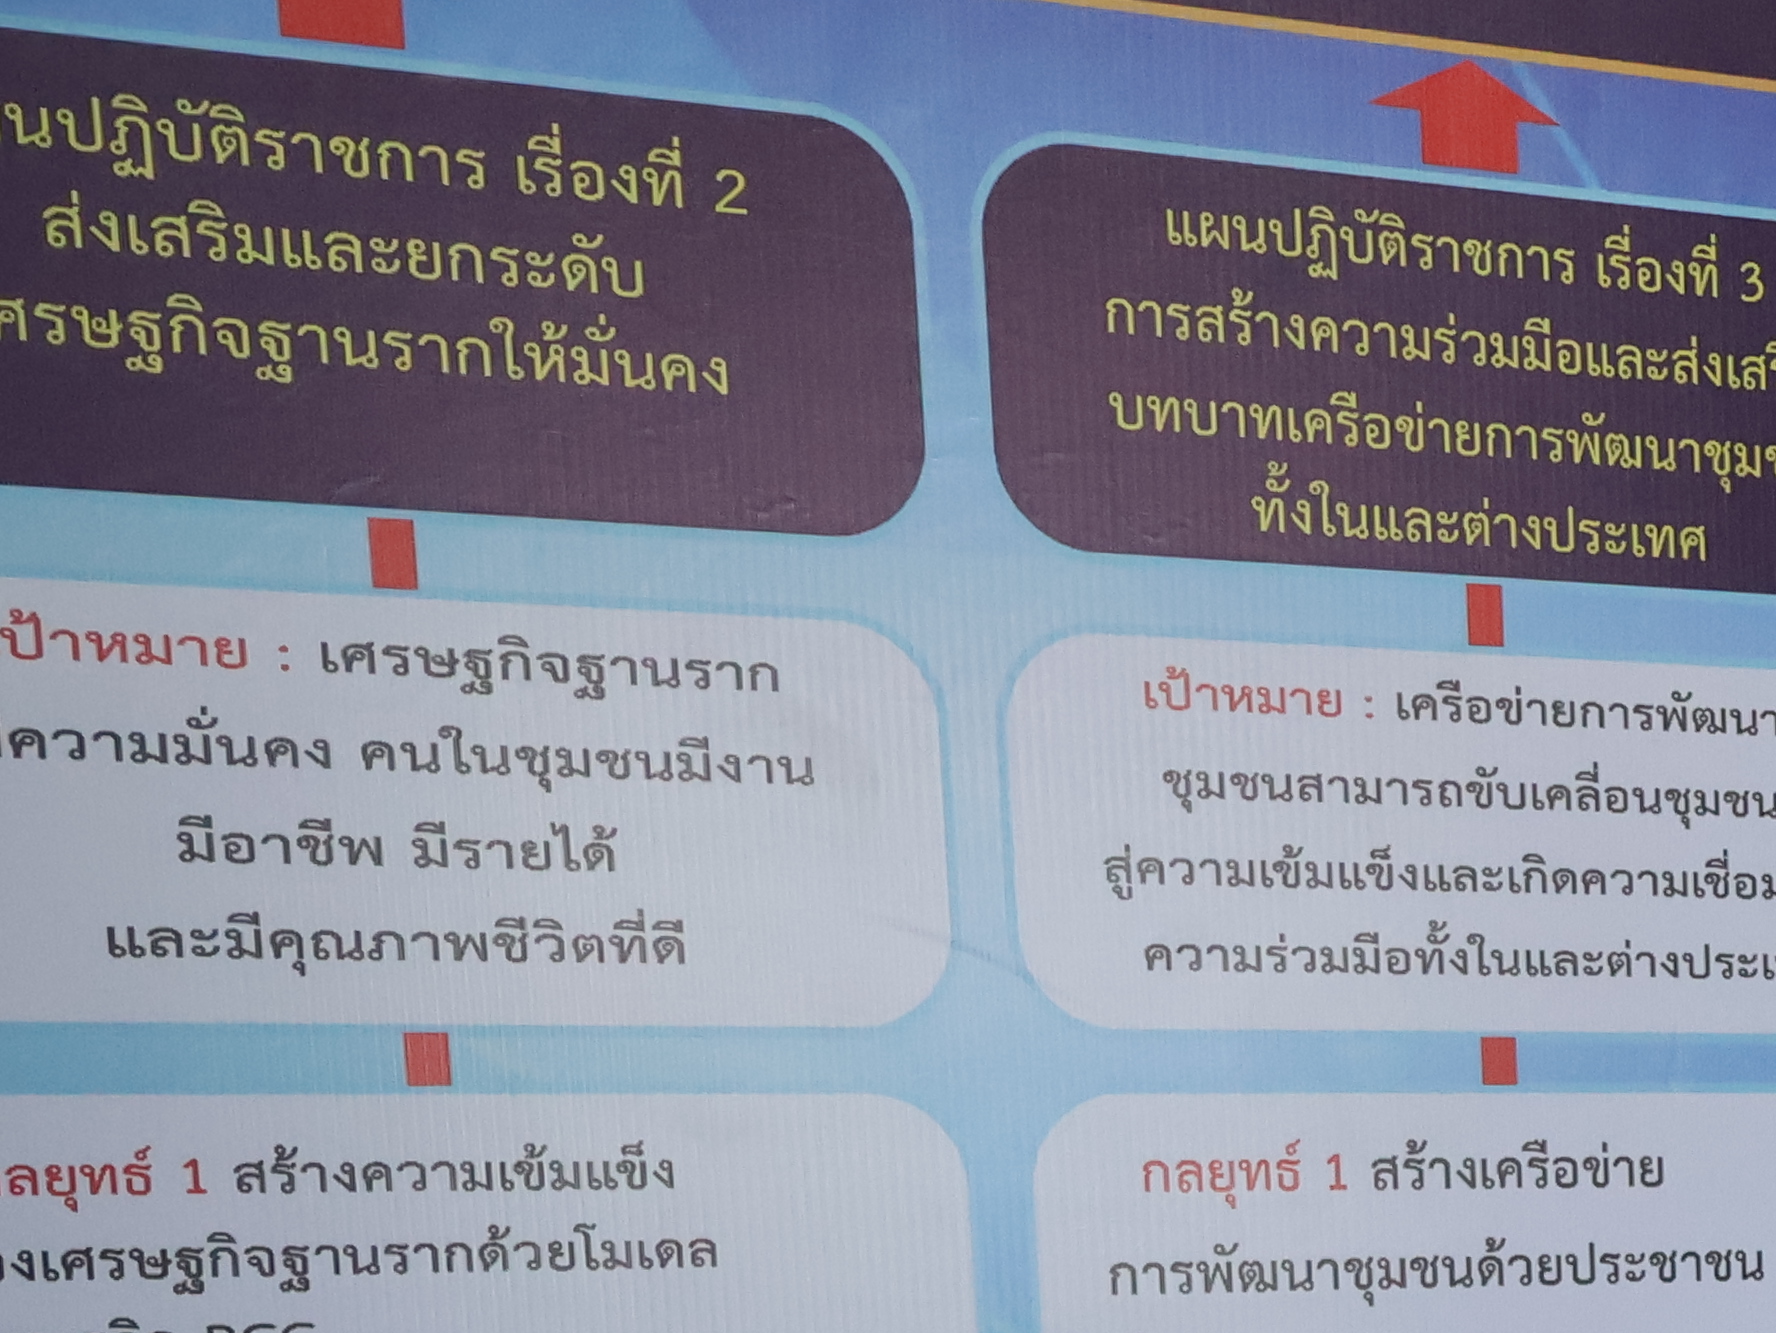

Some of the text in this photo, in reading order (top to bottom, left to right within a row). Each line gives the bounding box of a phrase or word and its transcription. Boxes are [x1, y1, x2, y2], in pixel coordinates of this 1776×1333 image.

[2, 92, 748, 216] นปฏิบัติราชการ เรื่องที่ 2
[42, 190, 645, 300] ส่งเสริมและยกระดับ
[1165, 203, 1766, 303] แผนปฏิบัติราชการ เรื่องที่ 3
[1251, 461, 1709, 564] ทั้งในและต่างประเทศ
[0, 608, 780, 699] ป้าหมาย : เศรษฐกิจฐานราก
[1143, 666, 1343, 720] เป้าหมาย
[1364, 694, 1375, 720] :
[0, 707, 815, 793] ความมั่นคง คนในชุมชนมีงาน
[177, 815, 617, 873] มีอาชีพ มีรายได้
[105, 908, 686, 977] และมีคุณภาพชีวิตที่ดี
[0, 1141, 675, 1212] ลยุทธ์ 1 สร้างความเข้มแข็ง
[1141, 1138, 1666, 1209] กลยุทธ์ 1 สร้างเครือข่าย
[0, 1225, 718, 1297] งเศรษฐกิจฐานรากด้วยโมเดล
[1109, 1235, 1766, 1309] การพัฒนาชุมชนด้วยประชาชน
